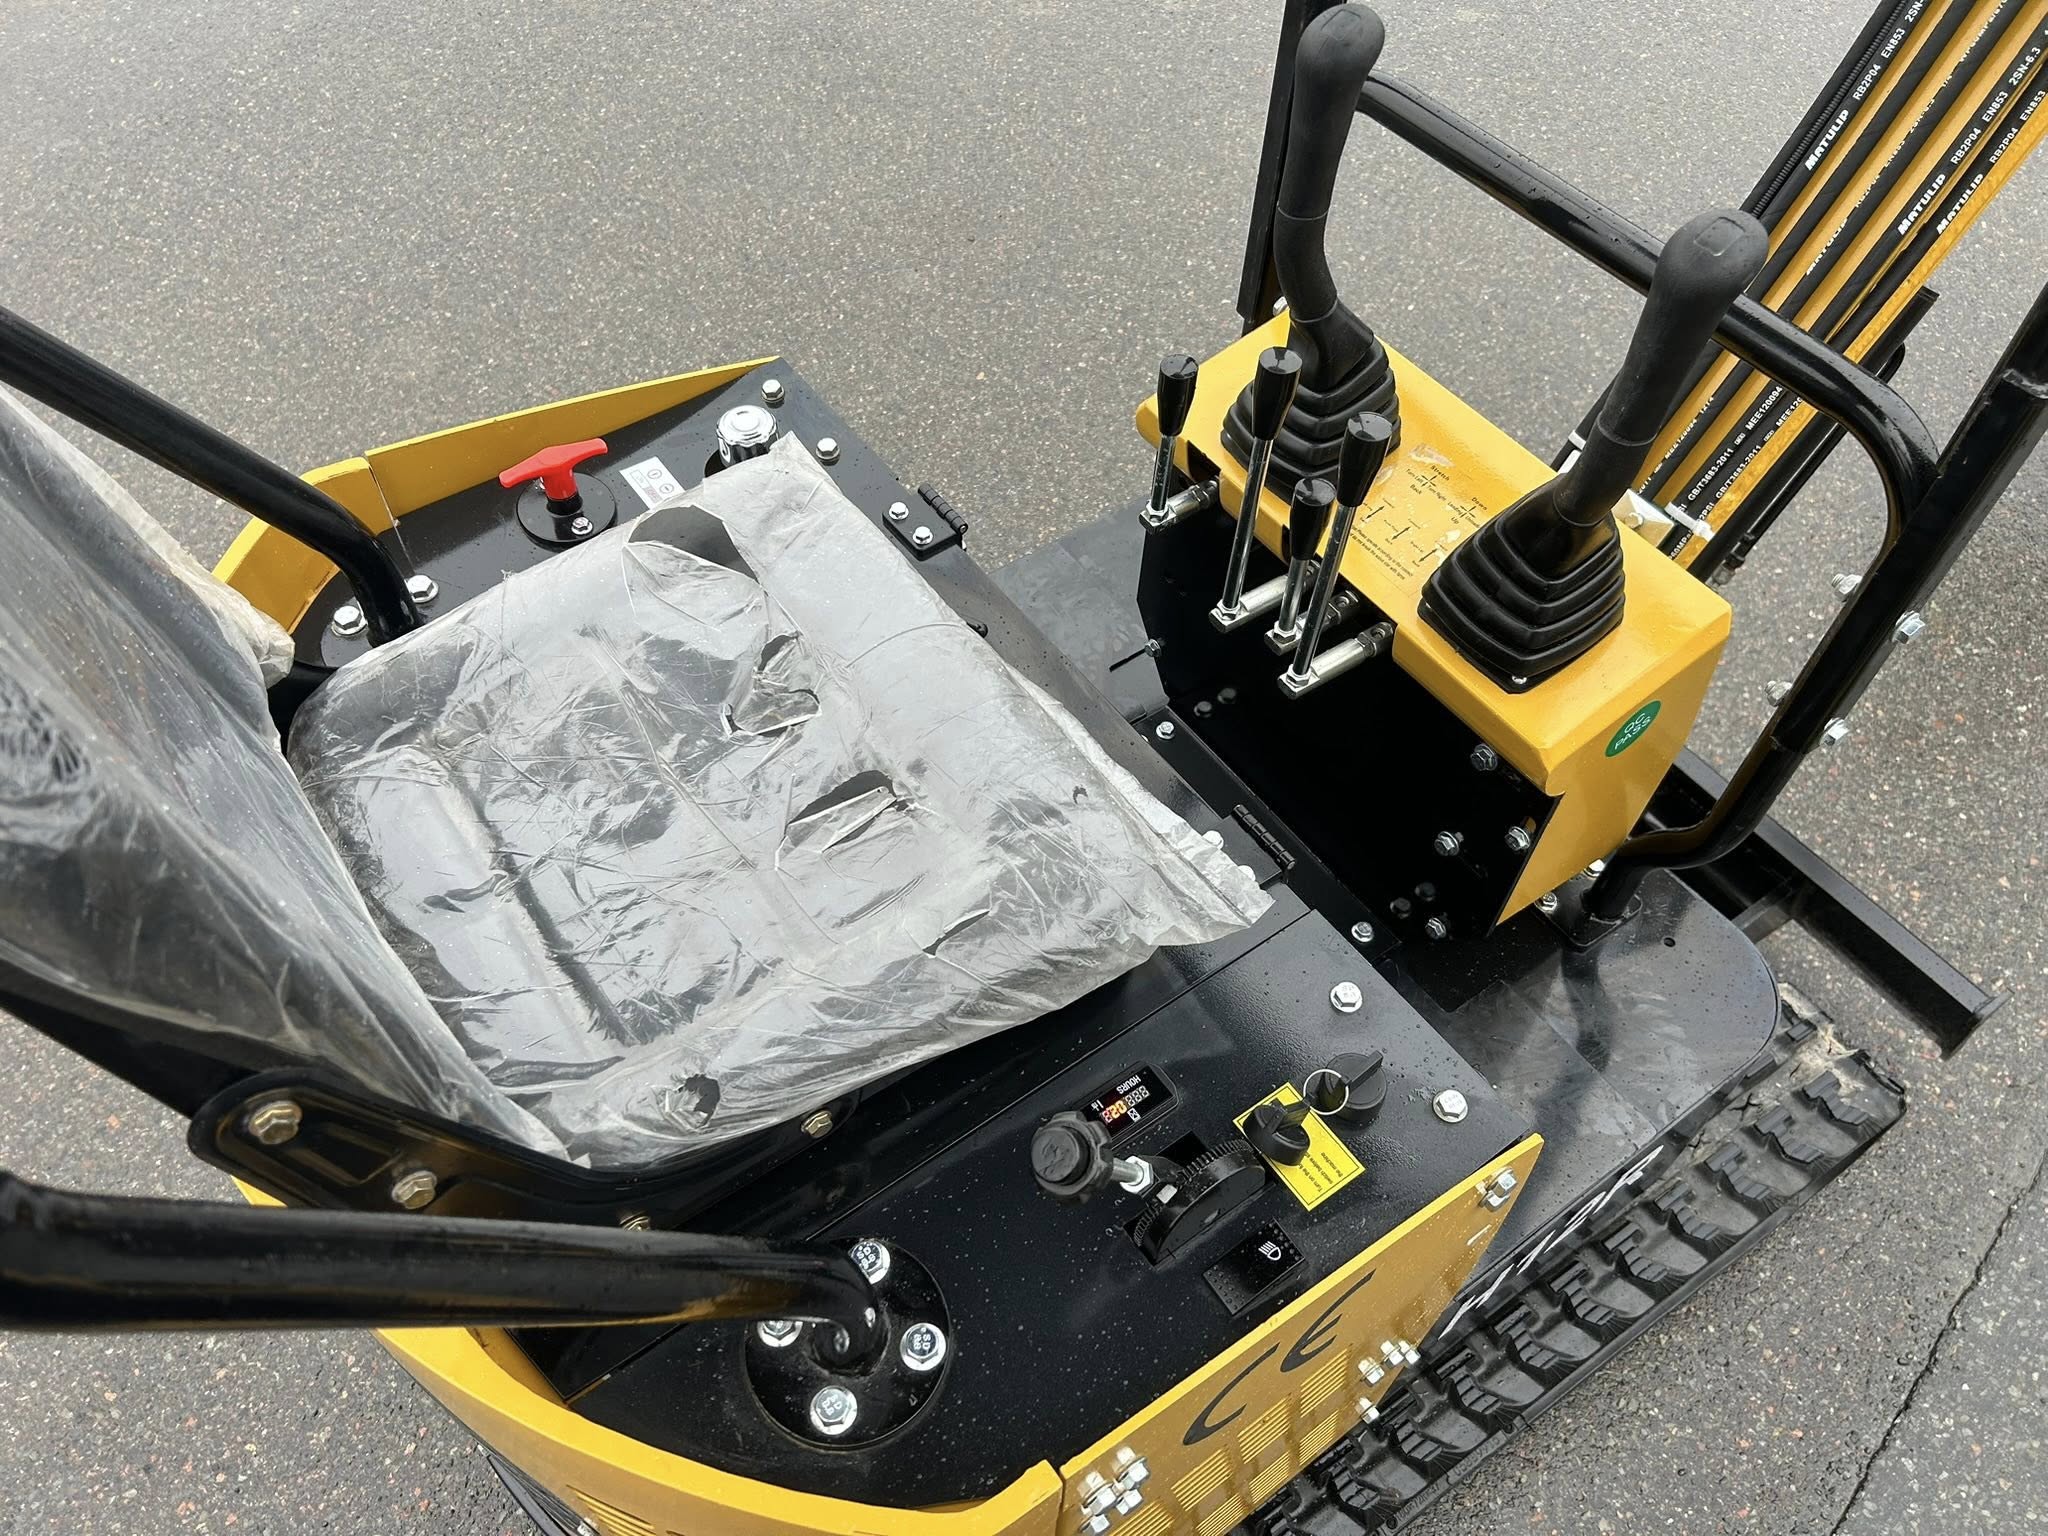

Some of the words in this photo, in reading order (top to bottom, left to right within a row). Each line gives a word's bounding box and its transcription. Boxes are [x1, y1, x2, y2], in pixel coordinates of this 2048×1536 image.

[1802, 106, 1850, 171] MATULIP
[1851, 61, 1882, 101] RB2P04
[1879, 25, 1906, 60] EN853
[1895, 170, 1947, 236] MATULIP
[1949, 125, 1982, 166] RB2P04
[1981, 89, 2009, 123] EN853
[2007, 44, 2042, 87] 2SN-6.3
[1934, 170, 1985, 236] MATULIP
[1988, 125, 2020, 165] RB2P04
[2019, 87, 2047, 122] EN853
[1743, 383, 1784, 432] MEE120094
[1614, 715, 1651, 750] PASS
[1624, 712, 1645, 733] QC
[1115, 1075, 1141, 1095] HOURS
[1183, 1268, 1376, 1445] CE
